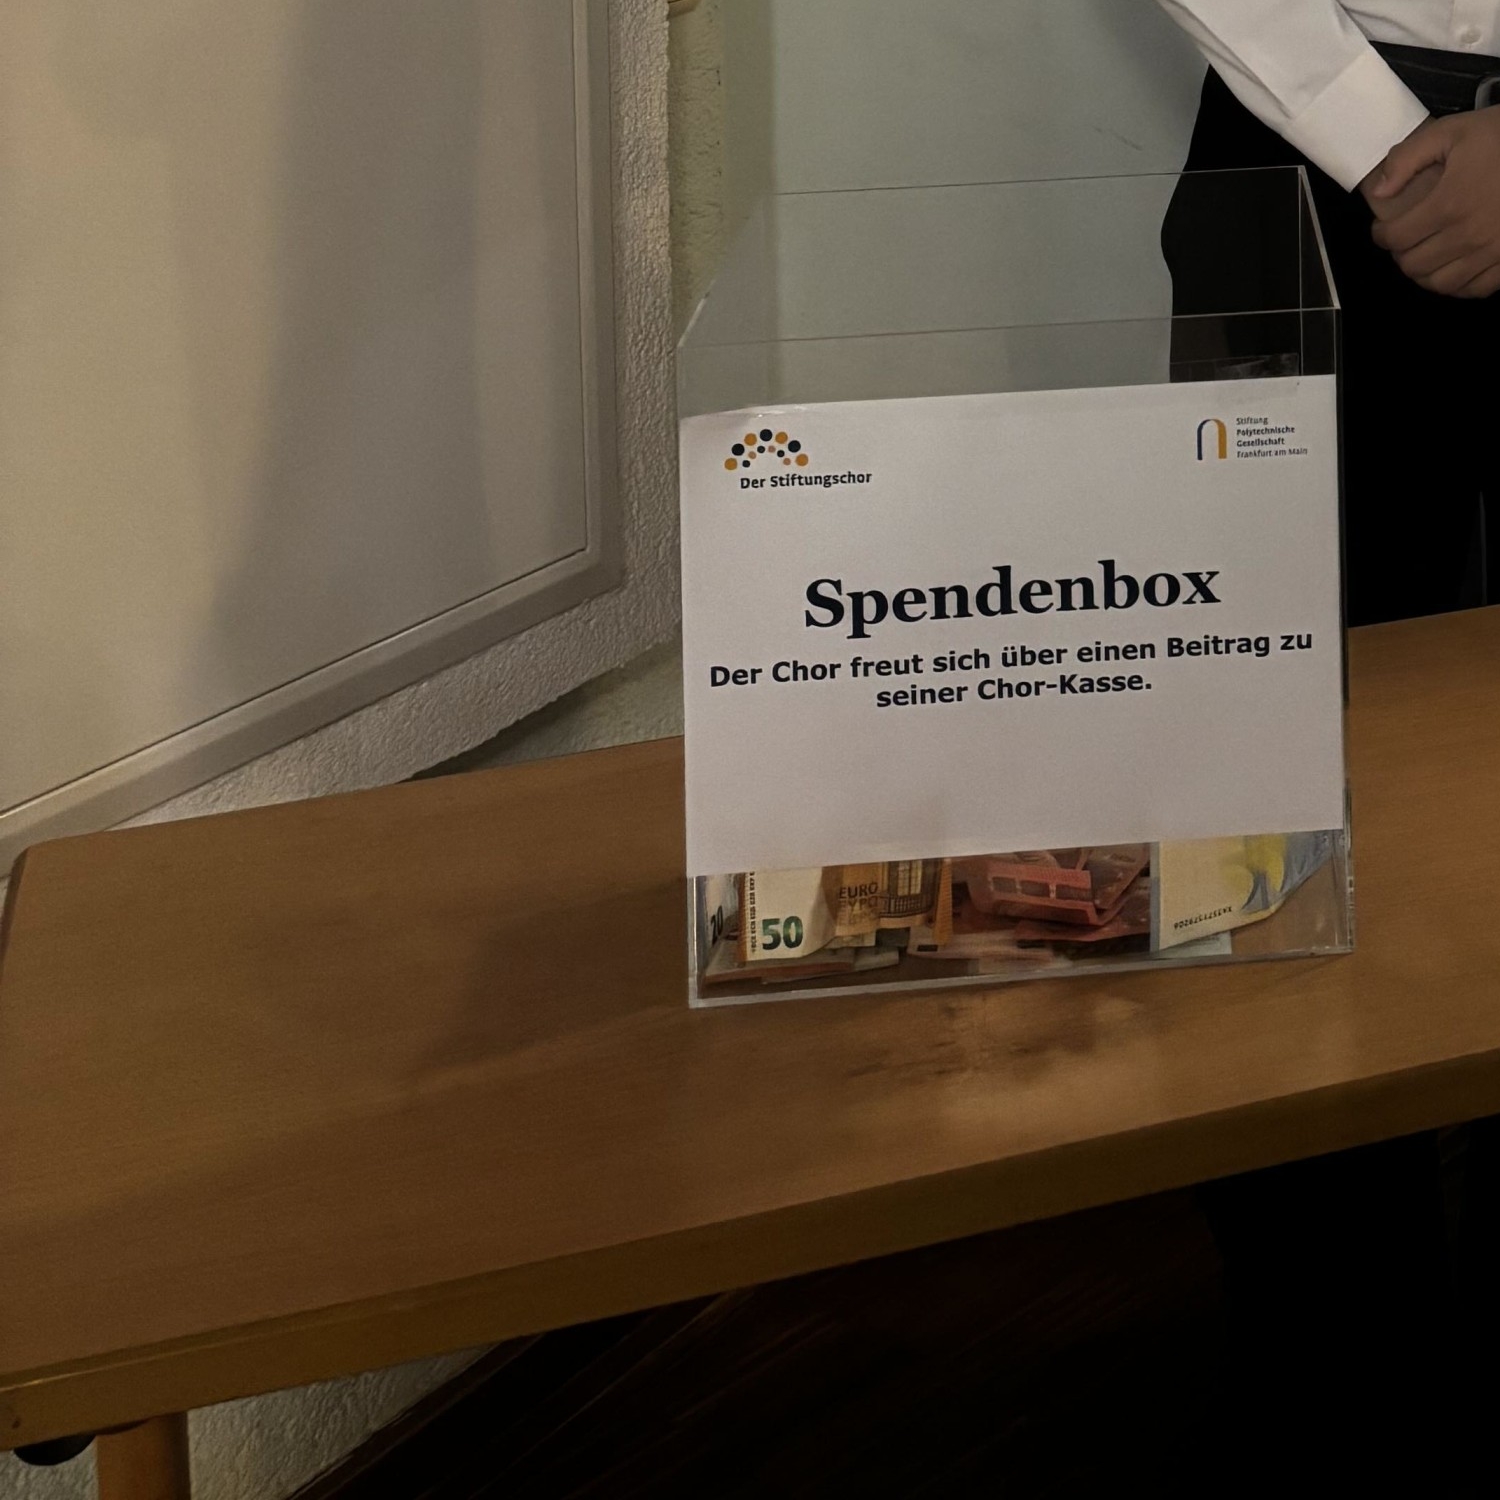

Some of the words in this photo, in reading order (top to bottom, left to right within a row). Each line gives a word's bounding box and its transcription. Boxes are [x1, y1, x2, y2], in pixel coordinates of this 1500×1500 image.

[1236, 416, 1268, 426] Stiftung
[1236, 426, 1295, 438] Polytechnische
[1236, 438, 1285, 447] Gesellschaft
[1237, 449, 1272, 458] Frankfurt
[1288, 447, 1308, 456] Main
[740, 476, 766, 489] Der
[770, 471, 873, 488] Stiftungschor
[804, 558, 1222, 640] Spendenbox
[710, 665, 763, 688] Der
[771, 660, 842, 683] Chor
[850, 653, 924, 678] freut
[932, 648, 991, 673] sich
[1001, 644, 1068, 668] über
[1076, 640, 1156, 663] einen
[1166, 633, 1270, 658] Beitrag
[1280, 633, 1313, 652] zu
[875, 683, 969, 708] seiner
[977, 673, 1152, 700] Chor-Kasse.
[839, 882, 879, 899] EURO
[761, 915, 804, 951] 50
